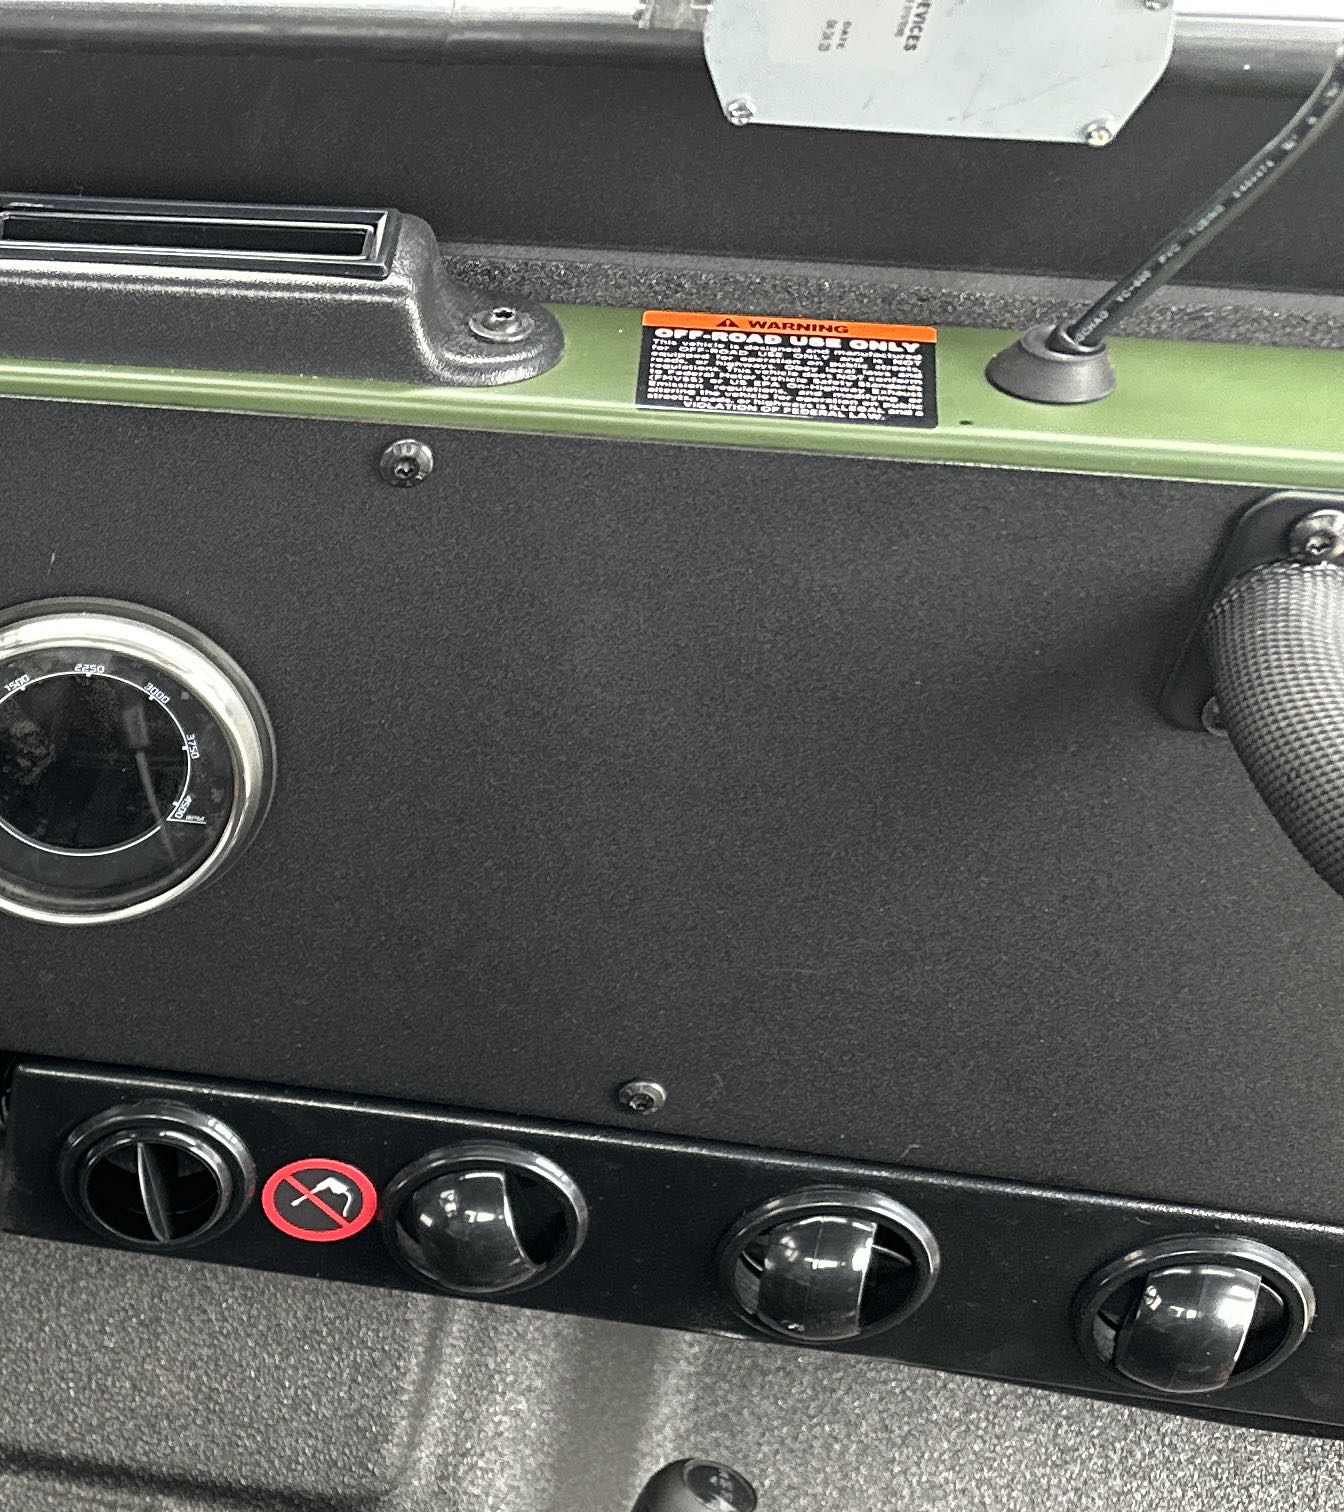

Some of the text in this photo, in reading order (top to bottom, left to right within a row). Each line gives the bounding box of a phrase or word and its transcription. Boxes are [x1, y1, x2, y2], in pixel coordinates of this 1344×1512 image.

[749, 321, 848, 333] WARNING
[656, 329, 919, 352] OFF-ROAD USE ONLY
[684, 401, 757, 411] VIOLATION
[784, 408, 845, 417] FEDERAL
[73, 663, 106, 674] 2250
[3, 673, 31, 694] 1500
[142, 681, 171, 705] 3000
[185, 733, 201, 760] 3750
[174, 794, 192, 820] 4500
